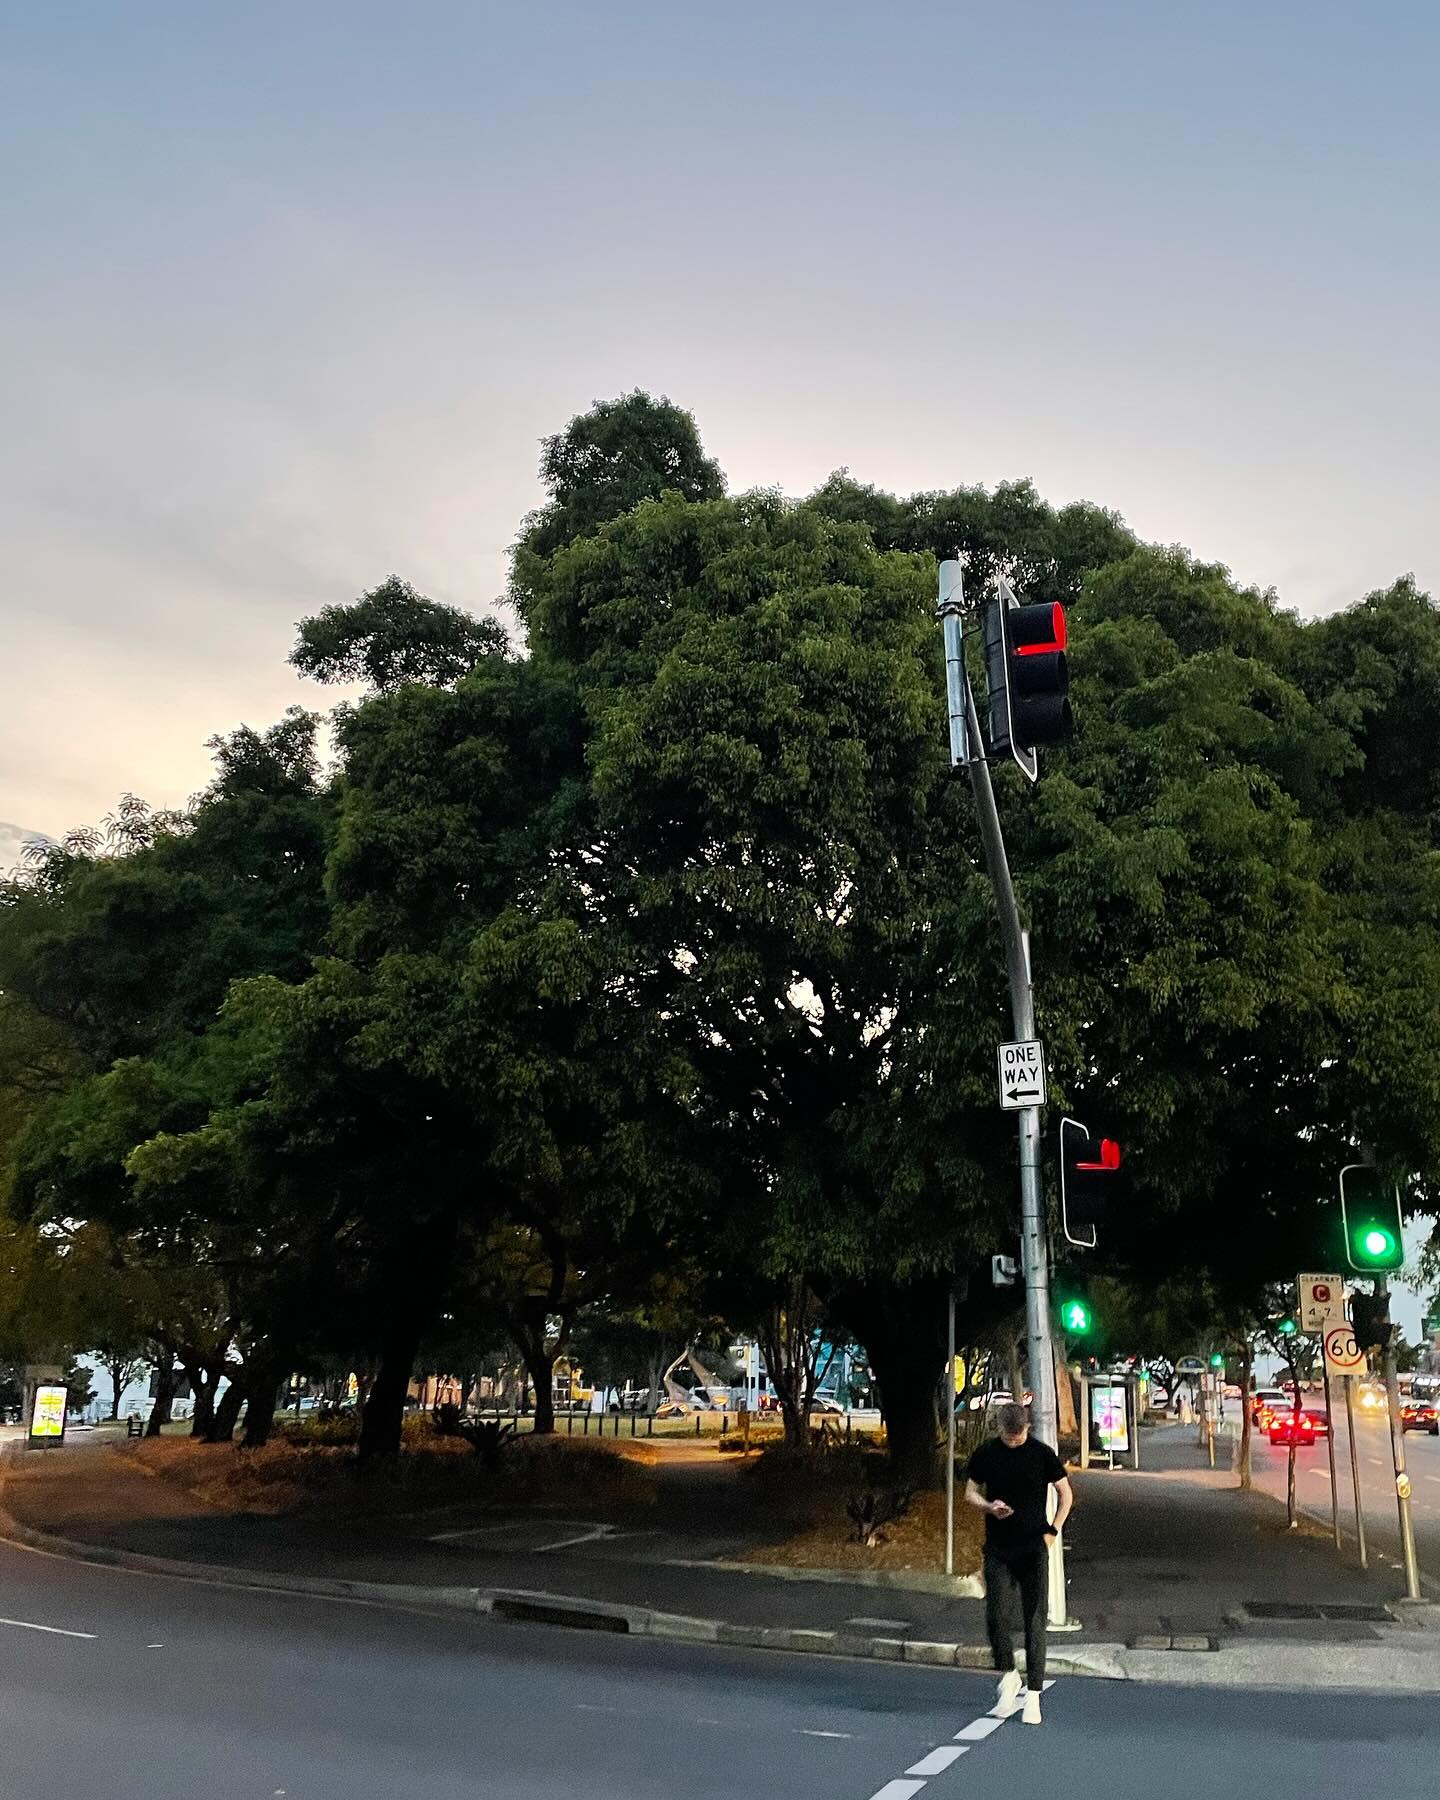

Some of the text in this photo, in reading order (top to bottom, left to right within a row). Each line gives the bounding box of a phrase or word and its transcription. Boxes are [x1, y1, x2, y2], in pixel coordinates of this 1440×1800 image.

[1005, 1046, 1036, 1064] ONE
[1004, 1066, 1039, 1085] WAY
[1331, 1338, 1359, 1357] 60
